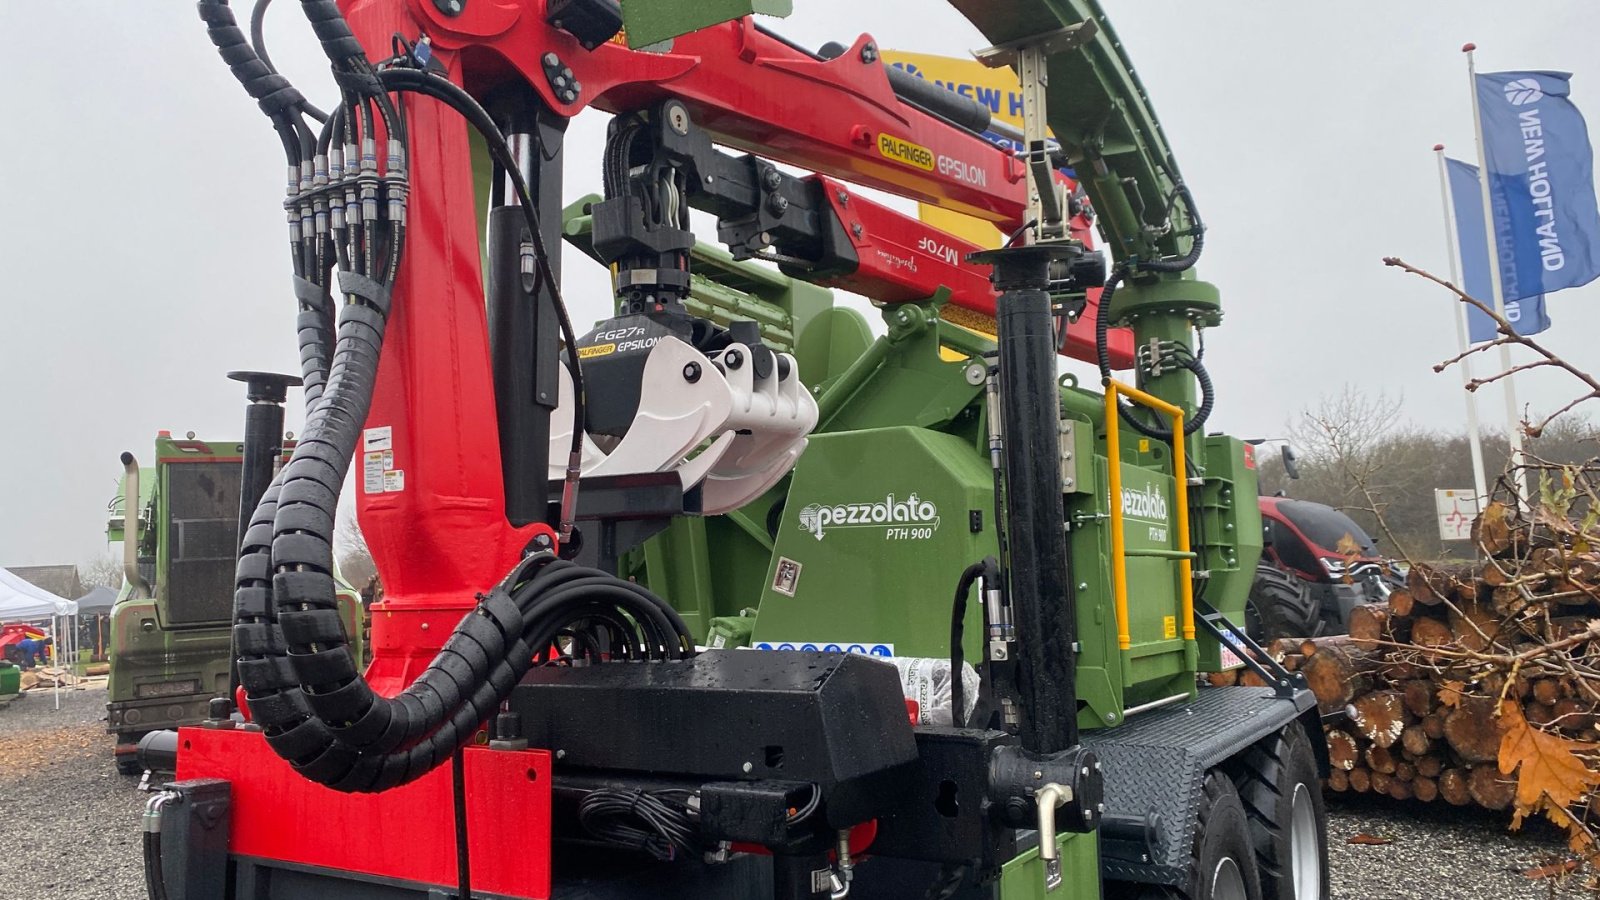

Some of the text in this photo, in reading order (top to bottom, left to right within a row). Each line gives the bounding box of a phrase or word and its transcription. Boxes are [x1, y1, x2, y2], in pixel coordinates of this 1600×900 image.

[881, 136, 987, 188] PALFINGER EPSILON
[917, 236, 959, 267] M70F
[594, 326, 646, 343] FG27R
[617, 336, 662, 353] EPSILON
[815, 493, 936, 541] pezzolato
[886, 528, 932, 540] PTH 900
